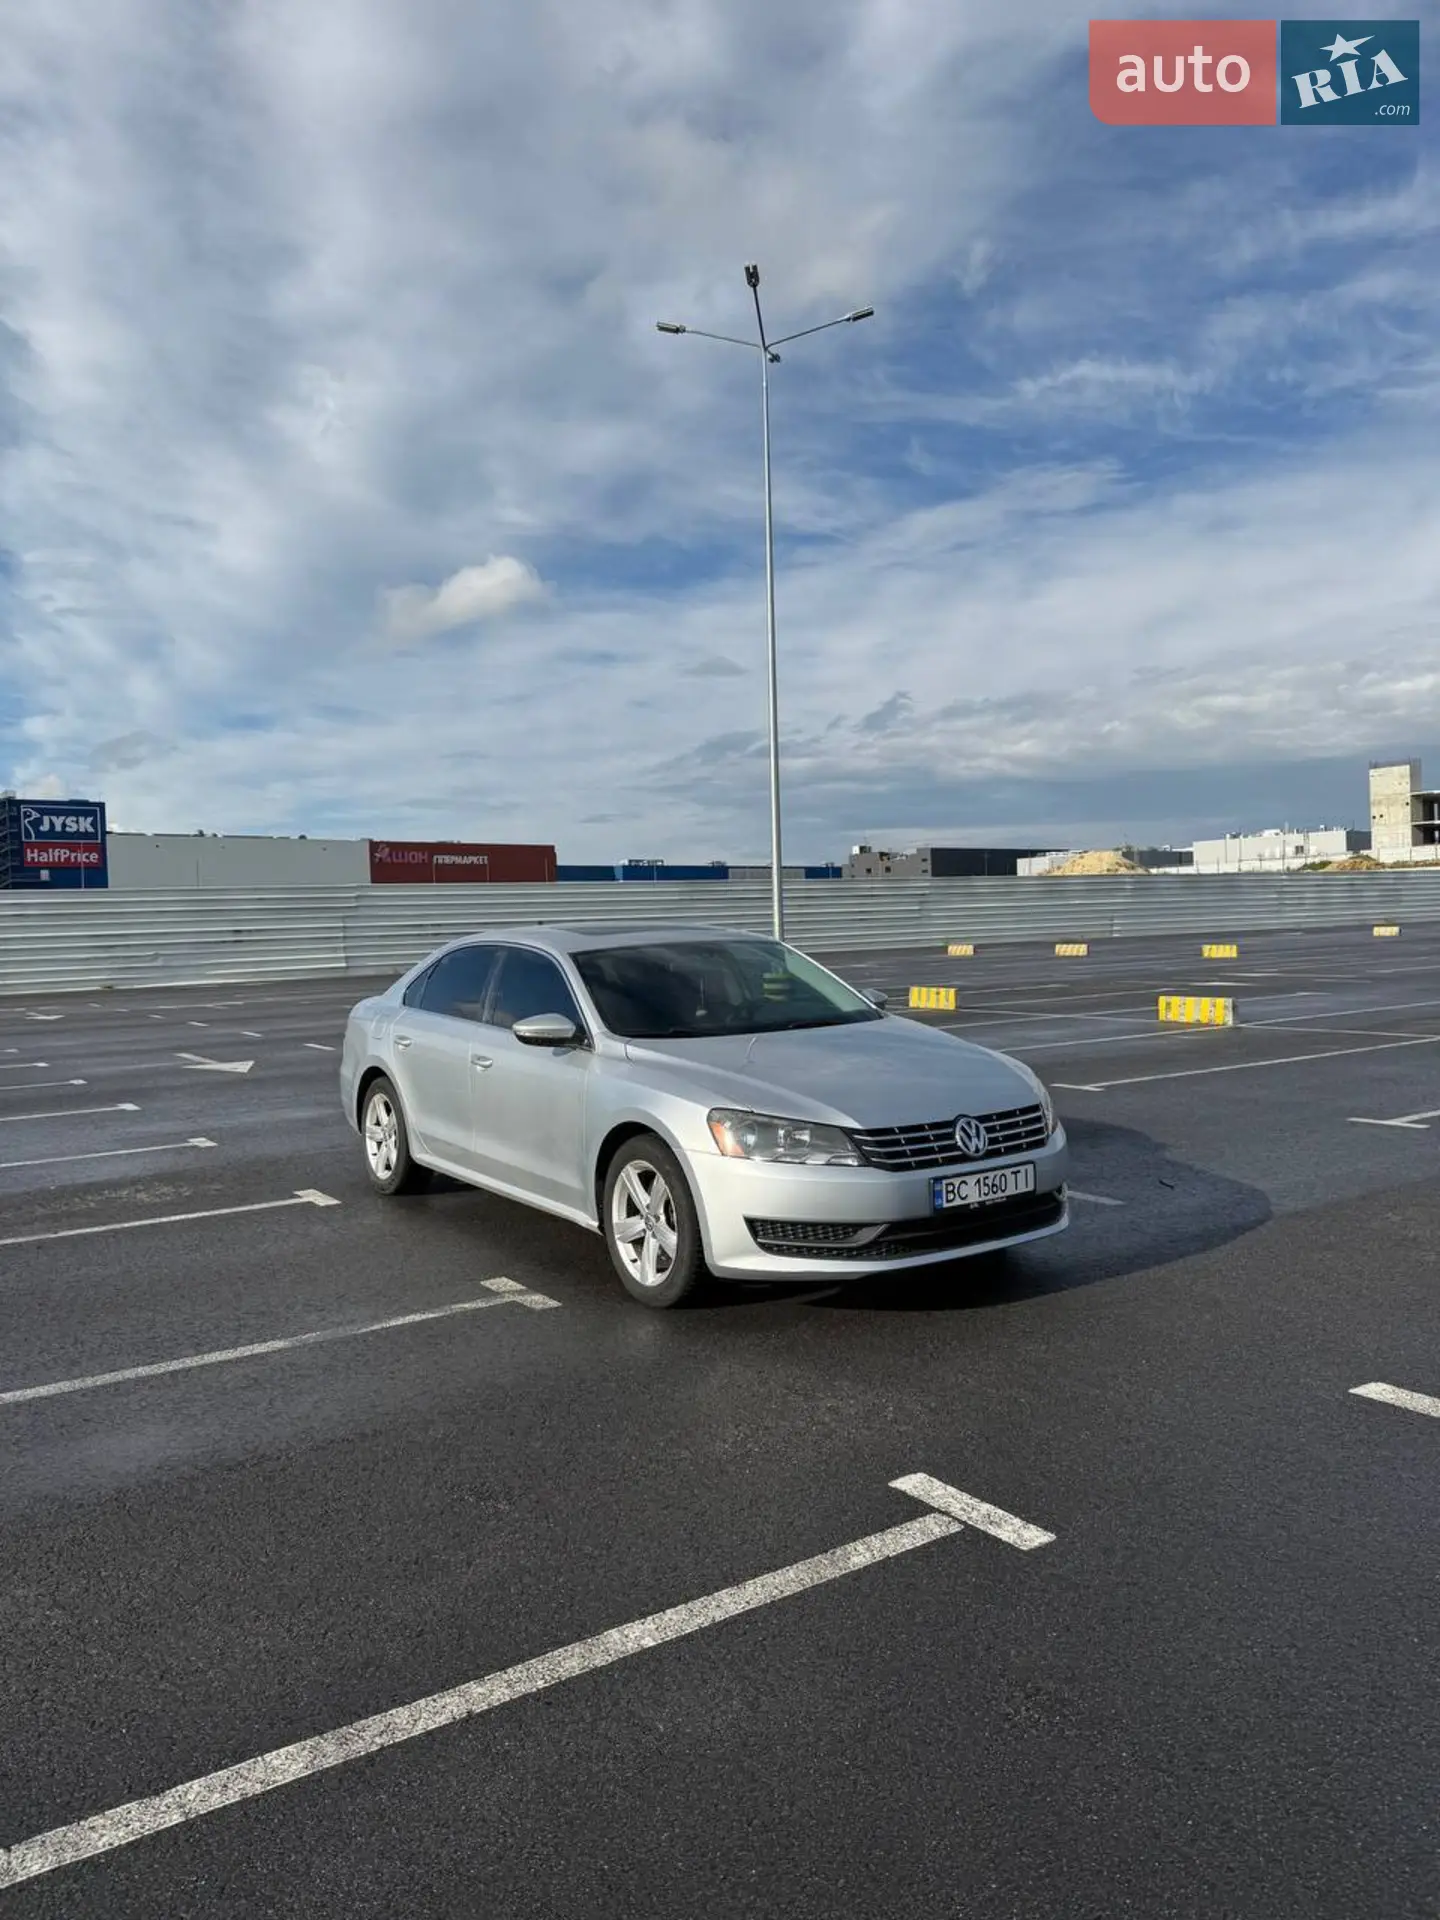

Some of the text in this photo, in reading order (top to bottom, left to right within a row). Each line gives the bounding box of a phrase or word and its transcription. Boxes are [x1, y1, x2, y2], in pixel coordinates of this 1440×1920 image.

[39, 815, 95, 833] JYSK
[26, 848, 99, 863] HalfPrice
[944, 1181, 968, 1203] BC
[974, 1174, 1007, 1198] 1560
